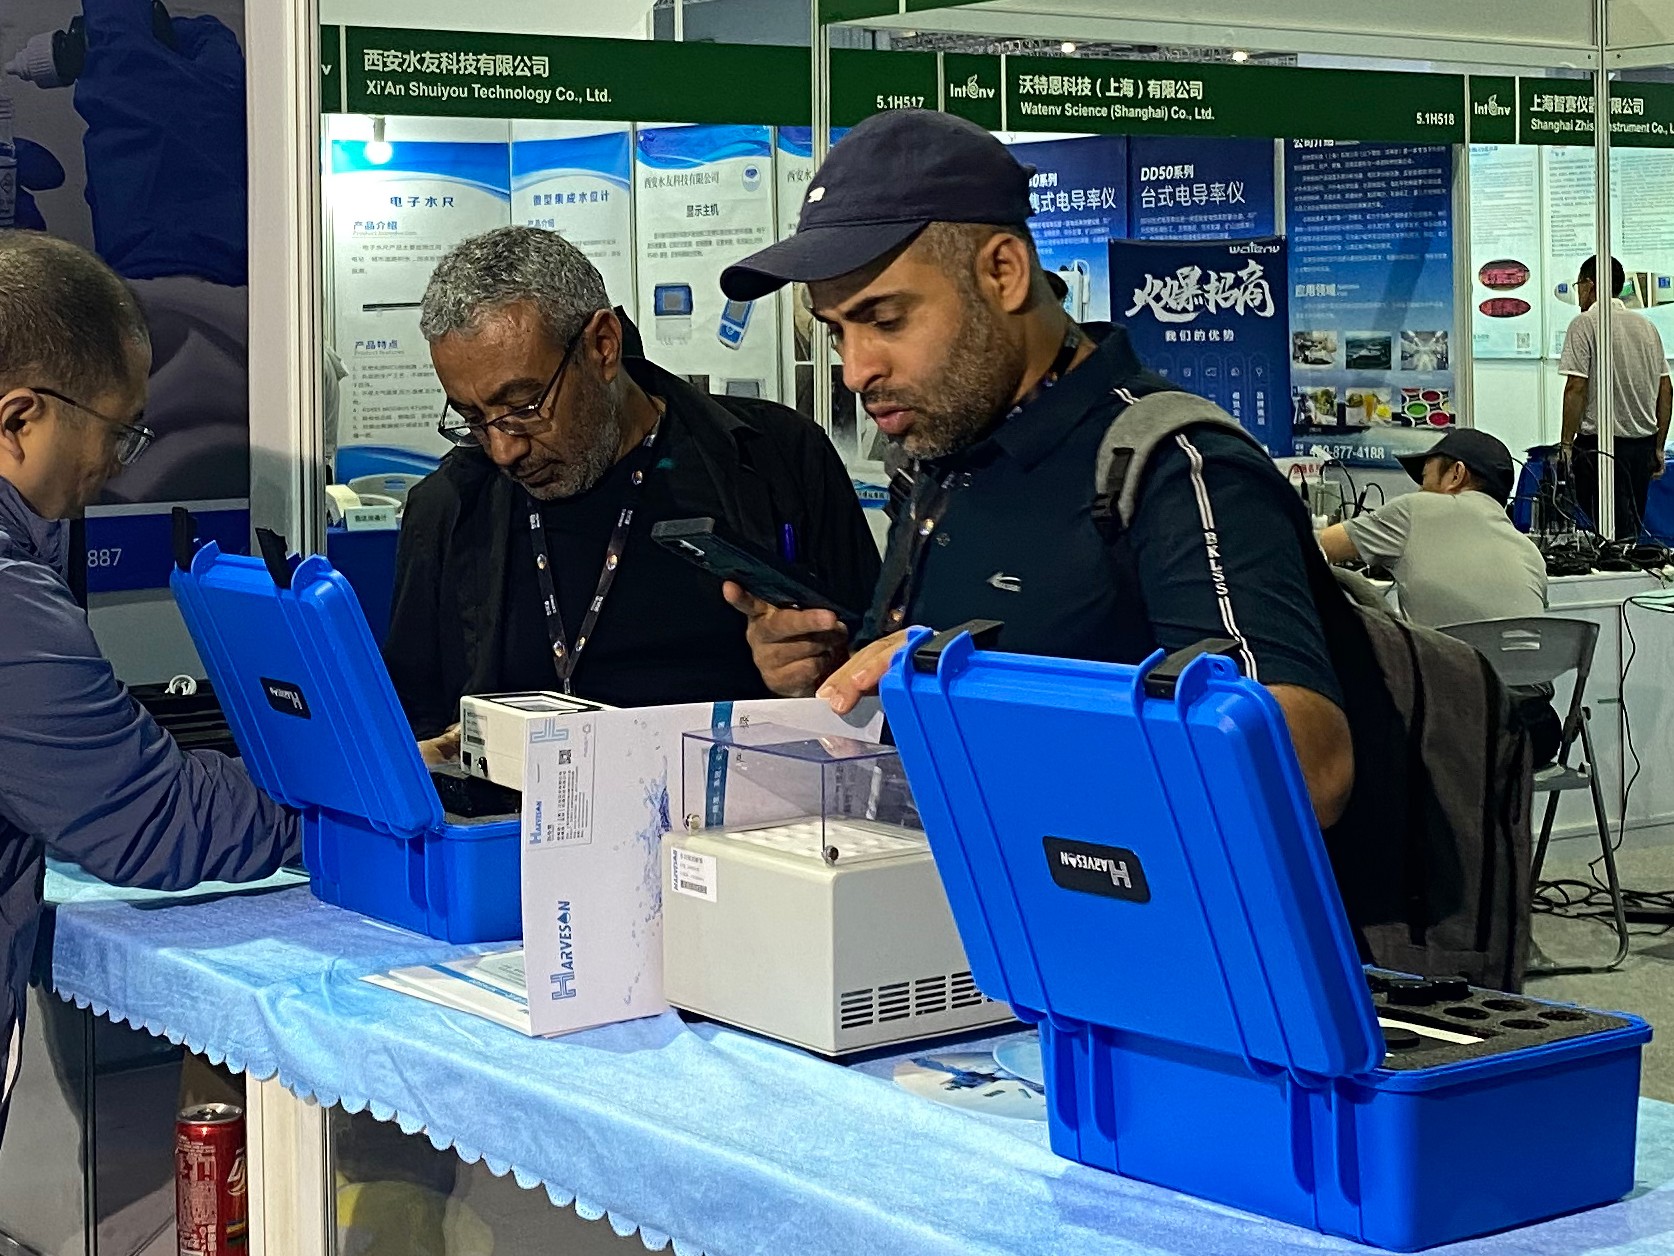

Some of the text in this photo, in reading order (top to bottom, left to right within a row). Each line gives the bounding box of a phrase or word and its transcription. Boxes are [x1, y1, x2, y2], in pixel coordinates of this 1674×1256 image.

[363, 49, 549, 78] 西安水友科技有限公司
[366, 80, 612, 103] Xi'An Shuiyou Technology Co., Ltd.
[876, 95, 925, 109] 5.1H517
[1020, 101, 1062, 117] Watenv
[1064, 103, 1108, 117] Science
[1110, 104, 1168, 121] (Shanghai)
[1195, 107, 1215, 120] Ltd.
[1416, 112, 1455, 125] 5.1H518
[1530, 118, 1574, 133] Shanghai
[644, 171, 720, 189] 西安水友科技有限公司
[1141, 164, 1194, 182] DD50系列
[390, 196, 454, 208] 电子水尺
[1141, 181, 1246, 209] 台式电导率仪
[686, 203, 719, 218] 显示主机
[353, 221, 398, 231] 产品介绍
[1125, 259, 1275, 323] 火爆招商
[1165, 329, 1235, 342] 我们的优势
[355, 340, 398, 350] 产品特点
[87, 548, 122, 567] 887
[1204, 532, 1228, 596] BKLSS
[549, 900, 577, 1001] HARVESON
